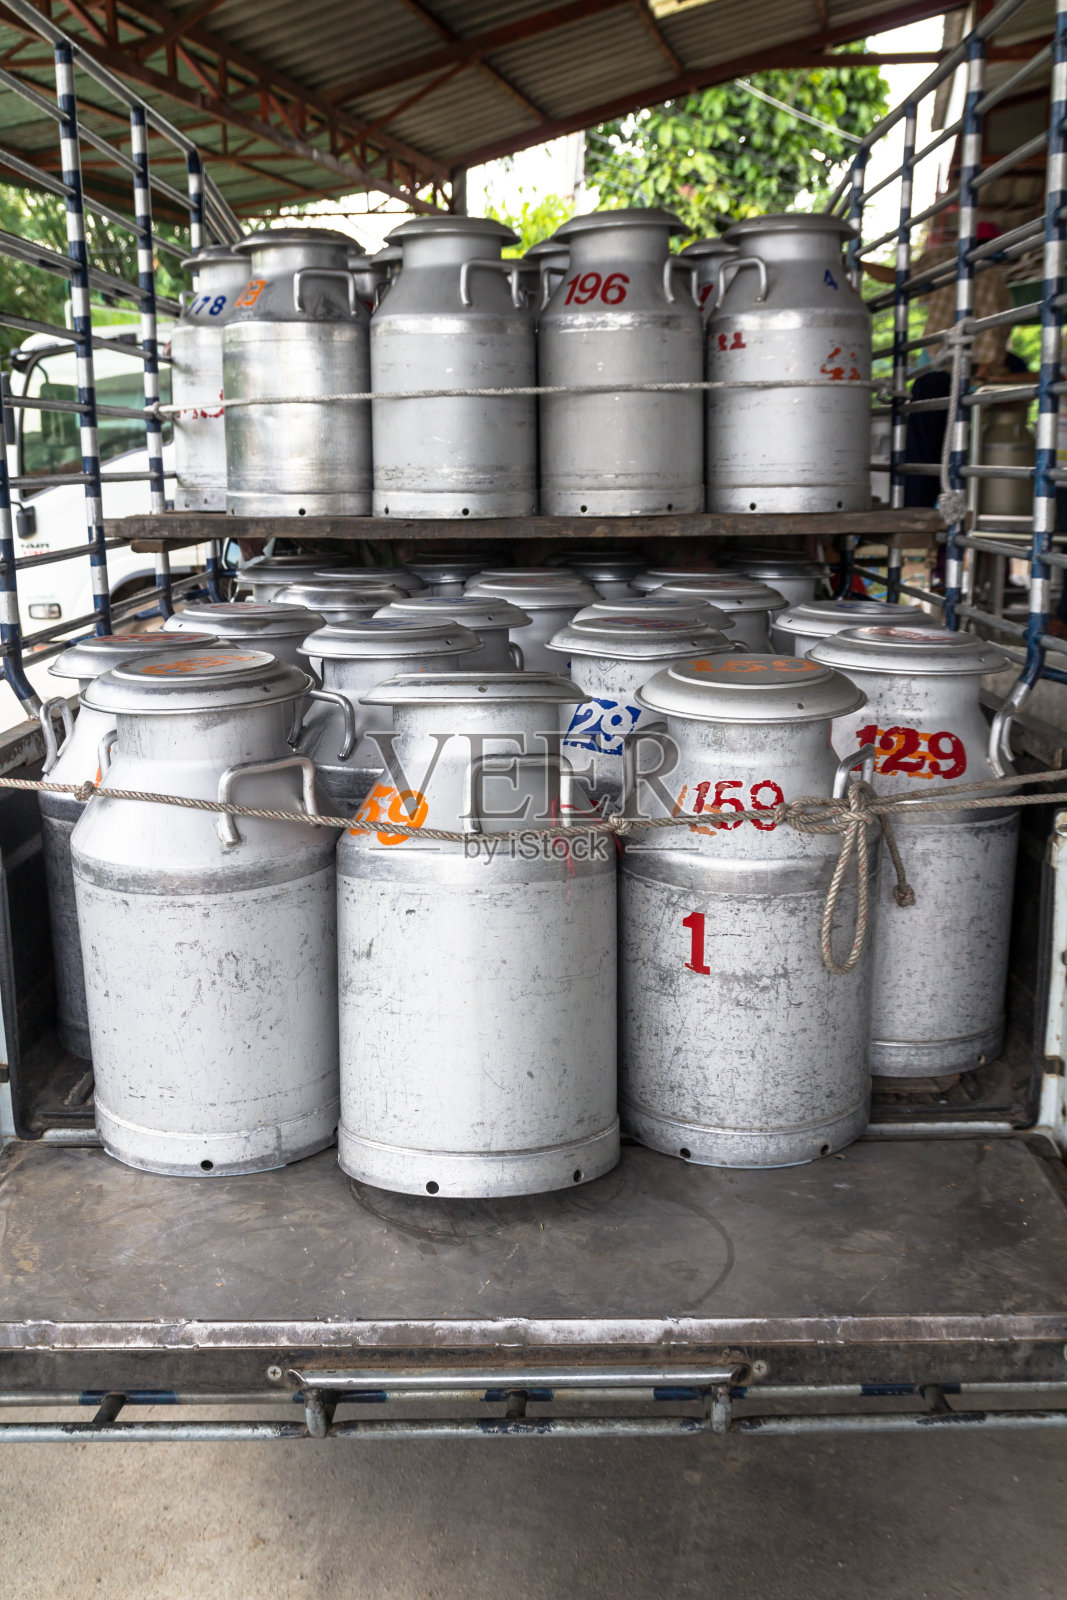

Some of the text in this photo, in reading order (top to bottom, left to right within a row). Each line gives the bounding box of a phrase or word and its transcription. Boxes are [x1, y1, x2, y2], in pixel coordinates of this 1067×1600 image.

[564, 271, 630, 305] 196
[850, 725, 967, 779] 129
[682, 912, 711, 976] 1
